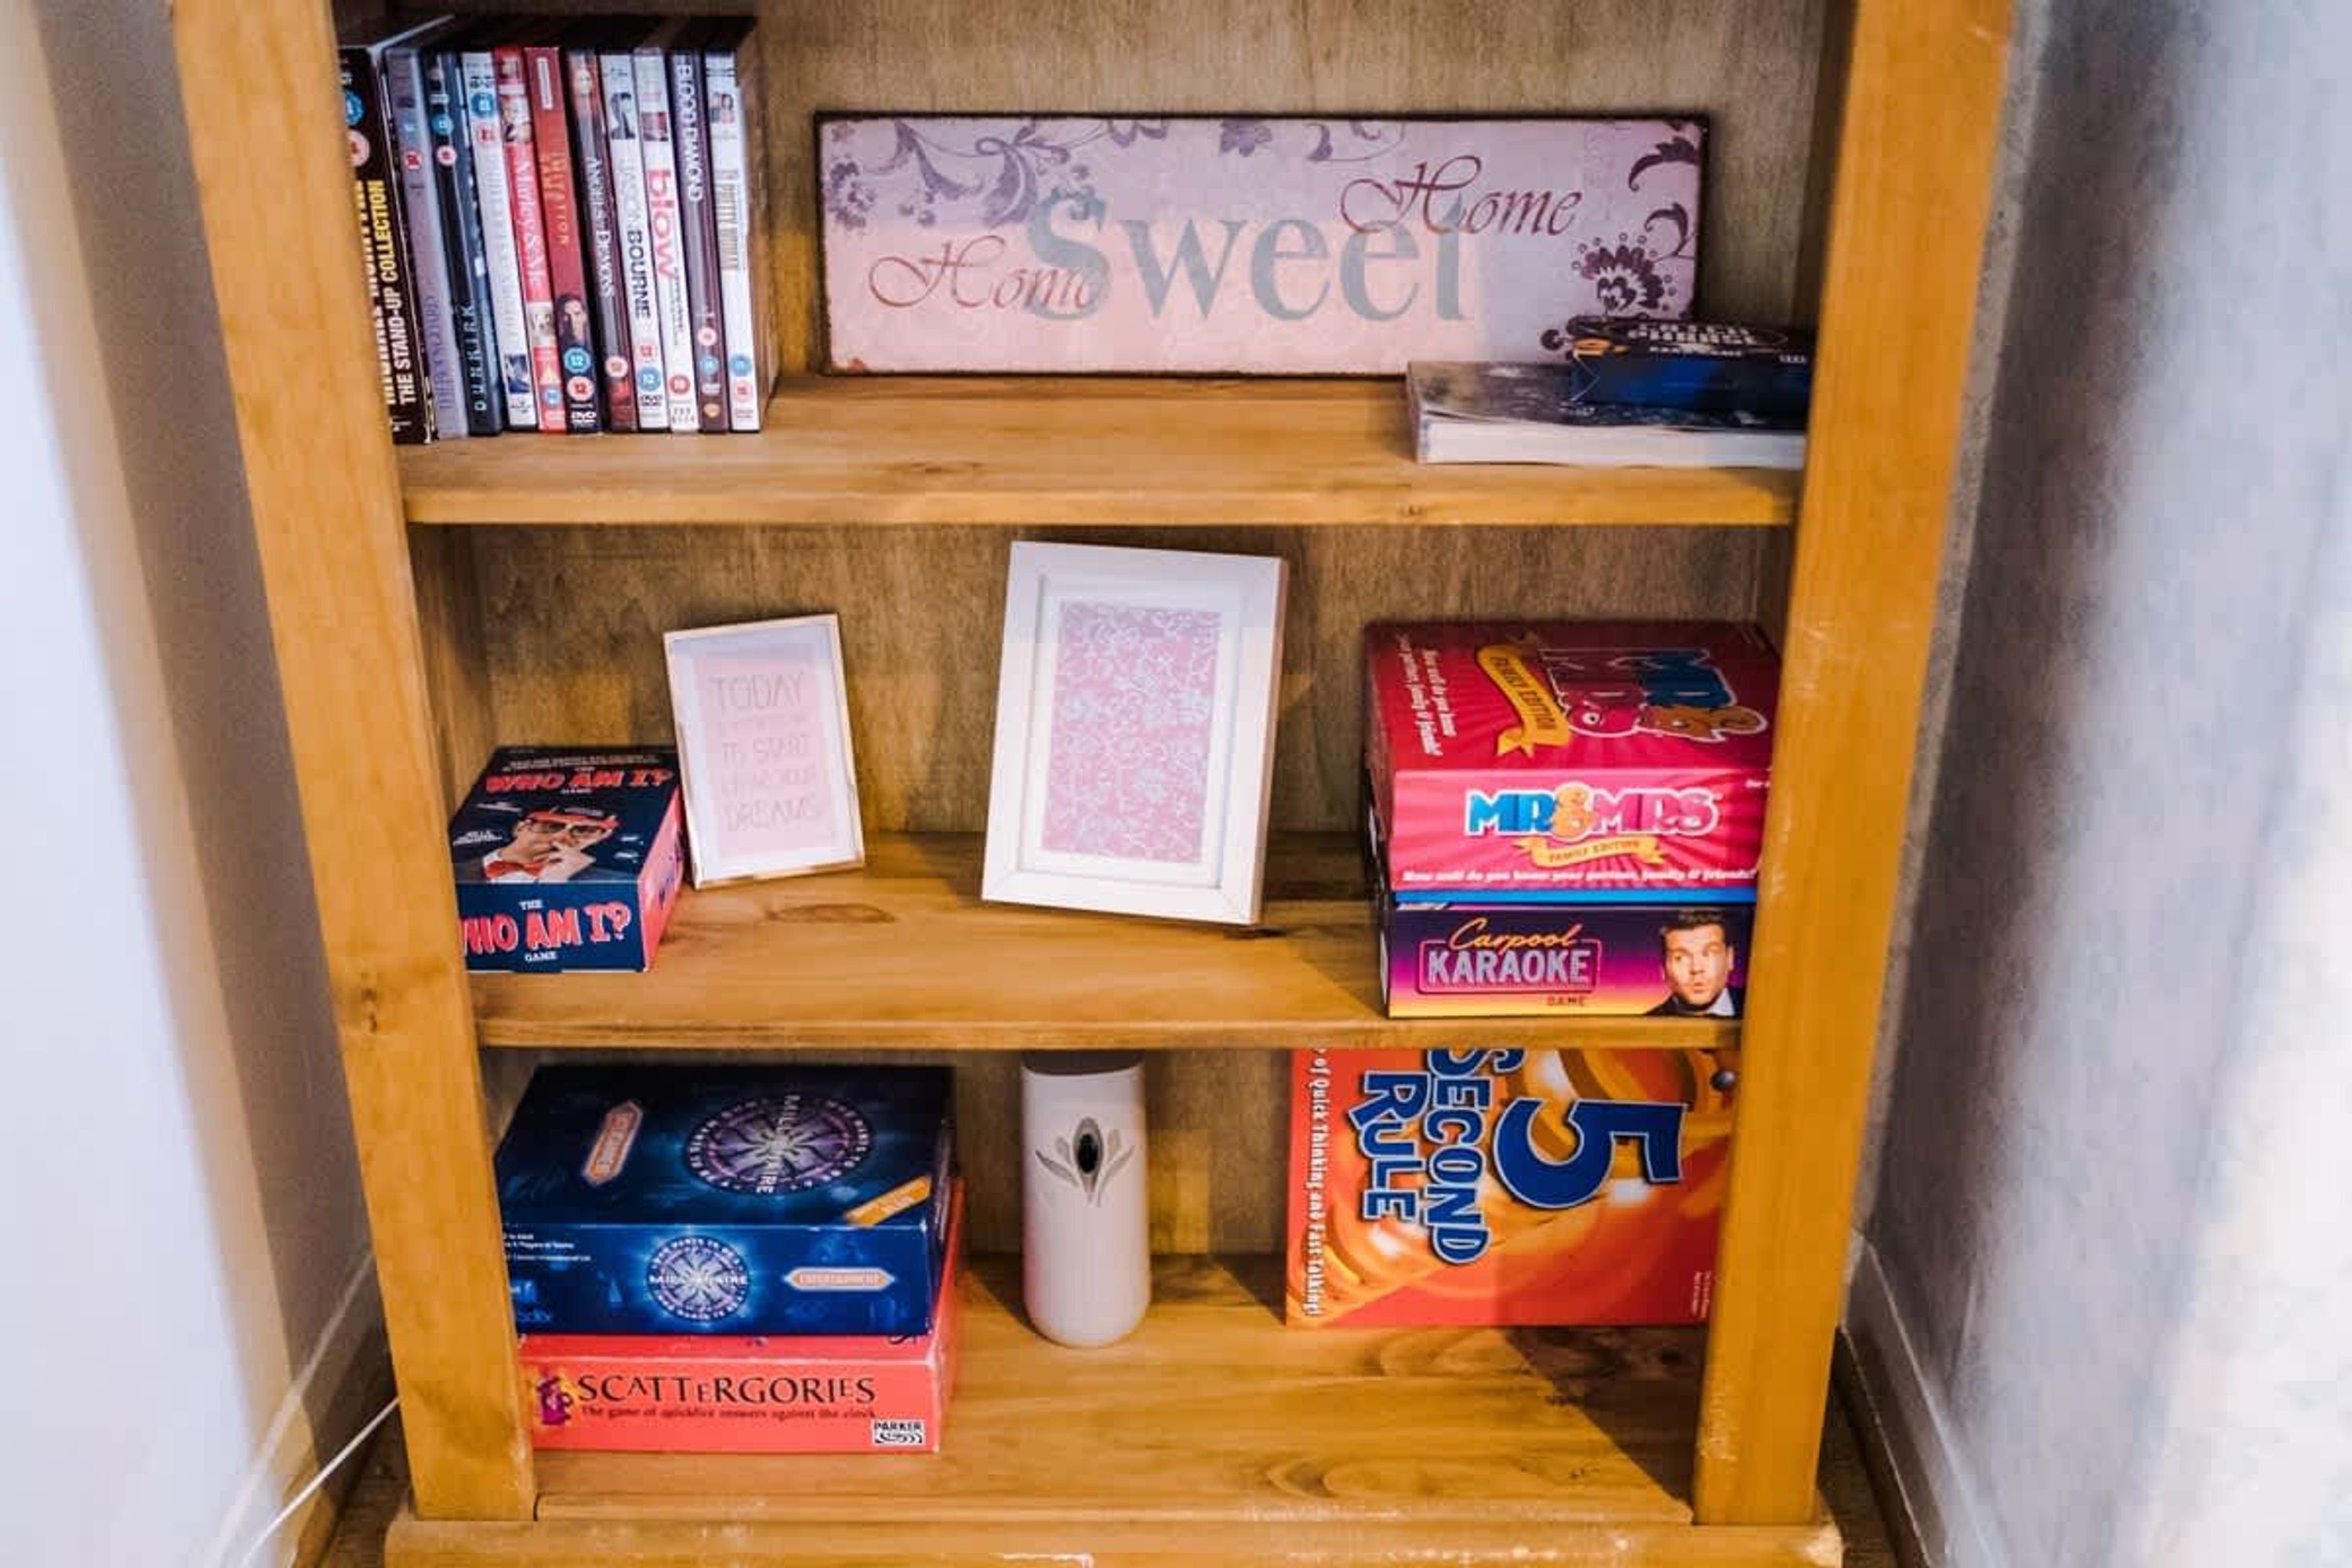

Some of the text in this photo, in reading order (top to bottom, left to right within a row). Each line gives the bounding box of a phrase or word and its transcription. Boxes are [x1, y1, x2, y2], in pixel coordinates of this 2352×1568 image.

[1341, 155, 1581, 235] Home
[367, 180, 399, 281] COLLECTION
[648, 169, 675, 278] blow
[627, 230, 650, 319] BOURNE
[383, 286, 411, 370] STAND-UP
[460, 303, 488, 412] DUNKIRK
[395, 373, 416, 405] THE
[708, 670, 804, 713] TODAY
[485, 770, 566, 793] WHO
[568, 770, 625, 788] AM
[518, 899, 544, 911] THE
[525, 906, 583, 950] AM
[583, 900, 632, 943] I?
[524, 950, 557, 963] GAME
[1449, 916, 1584, 957] Carpool
[1427, 949, 1592, 986] KARAOKE
[1545, 996, 1587, 1007] GAME
[1308, 1057, 1332, 1076] of
[1308, 1077, 1331, 1121] Quick
[1305, 1123, 1330, 1189] Thinking
[1348, 1069, 1431, 1222] RULE
[1494, 1097, 1689, 1210] 5
[1308, 1223, 1327, 1255] Fast
[1302, 1259, 1325, 1317] Talking!
[577, 1374, 876, 1404] SCATTERGORIES
[873, 1421, 922, 1432] PARKER
